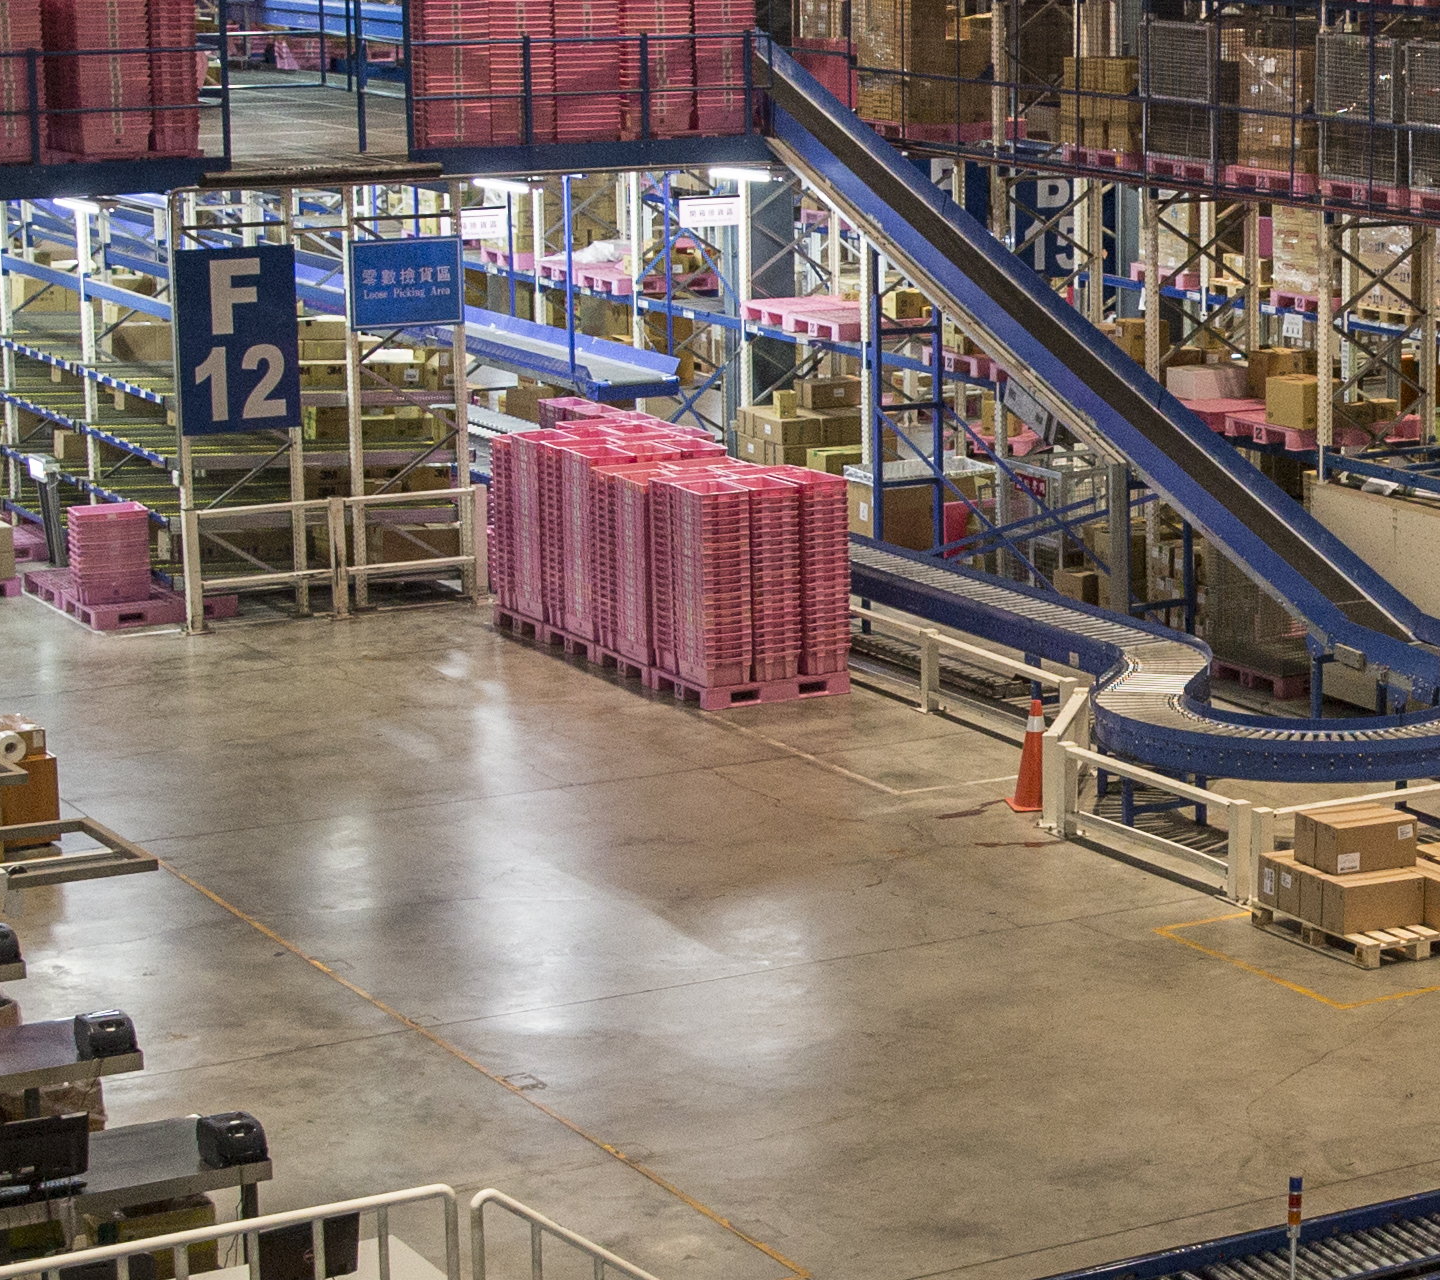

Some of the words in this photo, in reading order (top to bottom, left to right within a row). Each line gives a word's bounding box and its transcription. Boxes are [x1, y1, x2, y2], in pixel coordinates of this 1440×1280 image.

[210, 257, 260, 337] F
[363, 289, 388, 300] Loose
[393, 287, 426, 299] Picking
[430, 285, 451, 296] Area
[194, 343, 287, 423] 12
